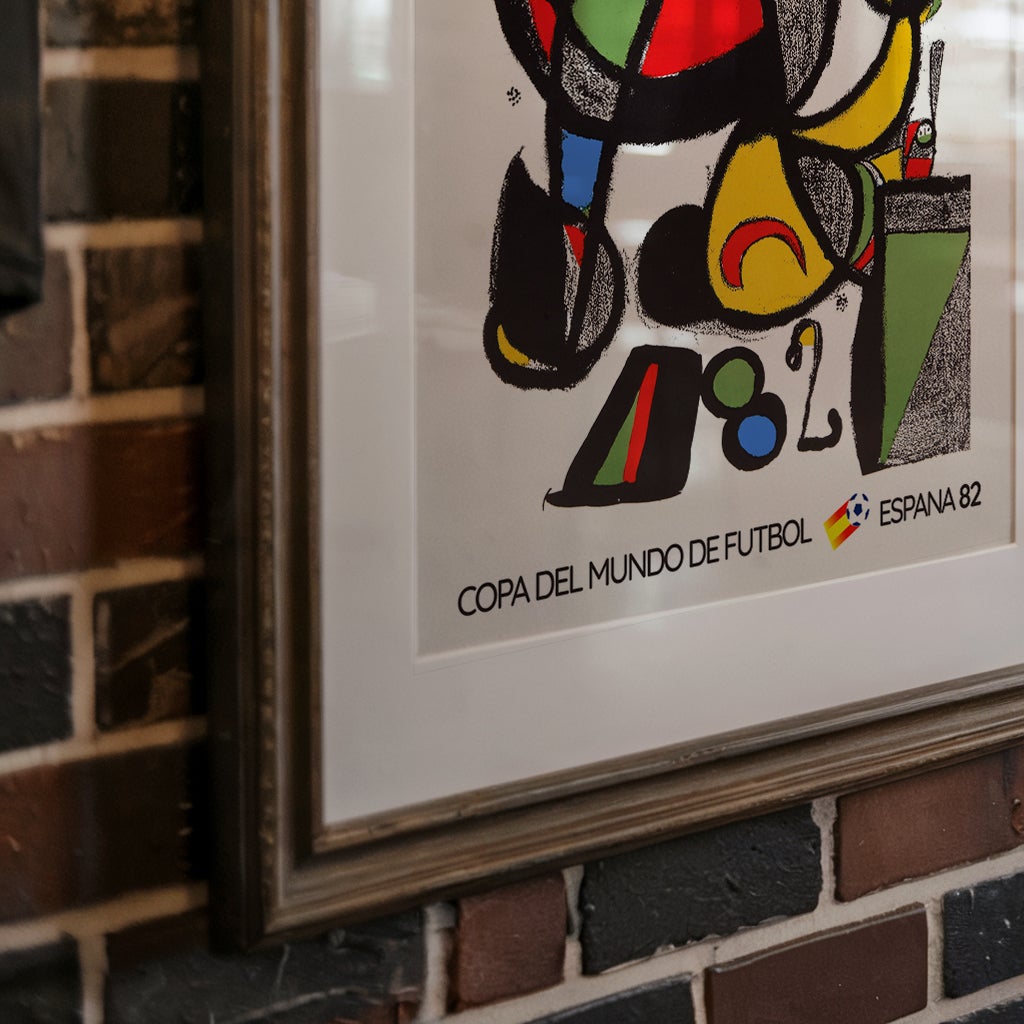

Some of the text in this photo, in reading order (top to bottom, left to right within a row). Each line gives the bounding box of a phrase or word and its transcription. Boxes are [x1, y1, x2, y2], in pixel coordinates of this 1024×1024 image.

[457, 480, 982, 617] COPA DEL MUNDO DE FUTBOL ESPANA 82
